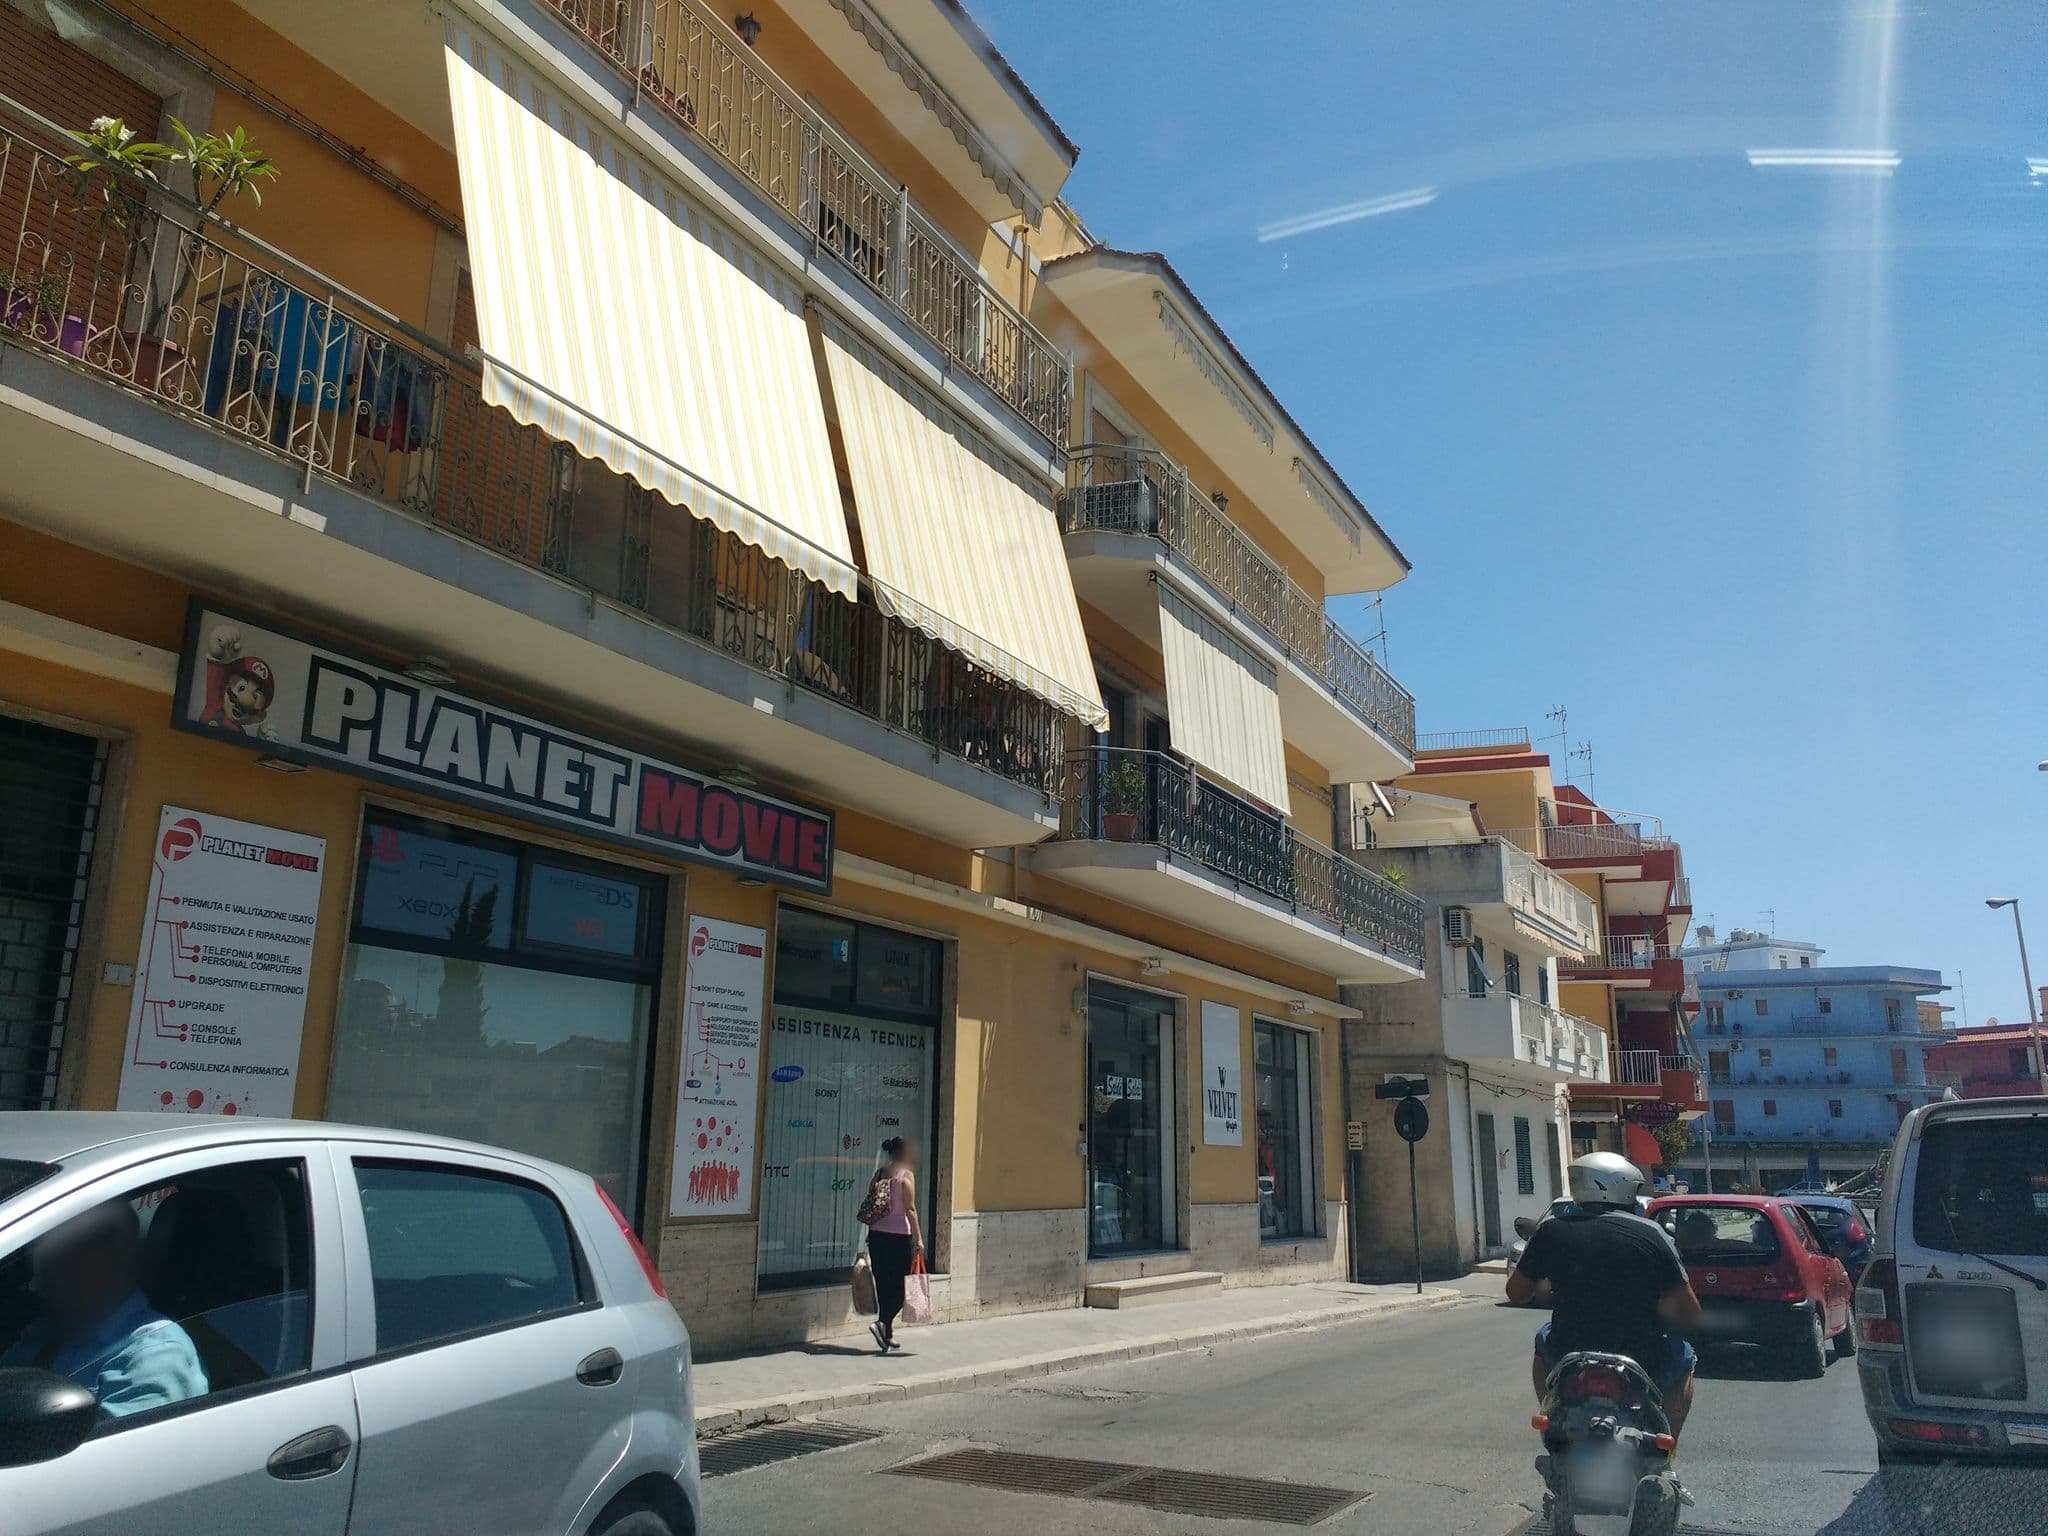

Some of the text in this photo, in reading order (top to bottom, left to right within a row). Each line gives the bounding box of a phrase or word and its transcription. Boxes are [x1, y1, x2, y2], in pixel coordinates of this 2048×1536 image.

[302, 654, 830, 881] PLANET MOVIE
[201, 835, 265, 862] PLANET
[182, 897, 314, 925] PERMUTA E VALUTAZIONE USATO
[189, 921, 312, 945] ASSISTENZA E RIPARAZIONE
[203, 945, 290, 964] TELEFONIA MOBILE
[201, 955, 303, 975] PERSONAL COMPUTERS
[198, 976, 304, 995] DISPOSITIVI ELETTRONICI
[178, 1000, 224, 1012] UPGRADE
[191, 1023, 237, 1035] CONSOLE
[190, 1034, 242, 1045] TELEFONIA
[871, 1029, 926, 1050] TECNICA
[169, 1061, 289, 1076] CONSULENZA INFORMATICA
[815, 1089, 839, 1098] SONY
[1208, 1090, 1237, 1119] VELVET
